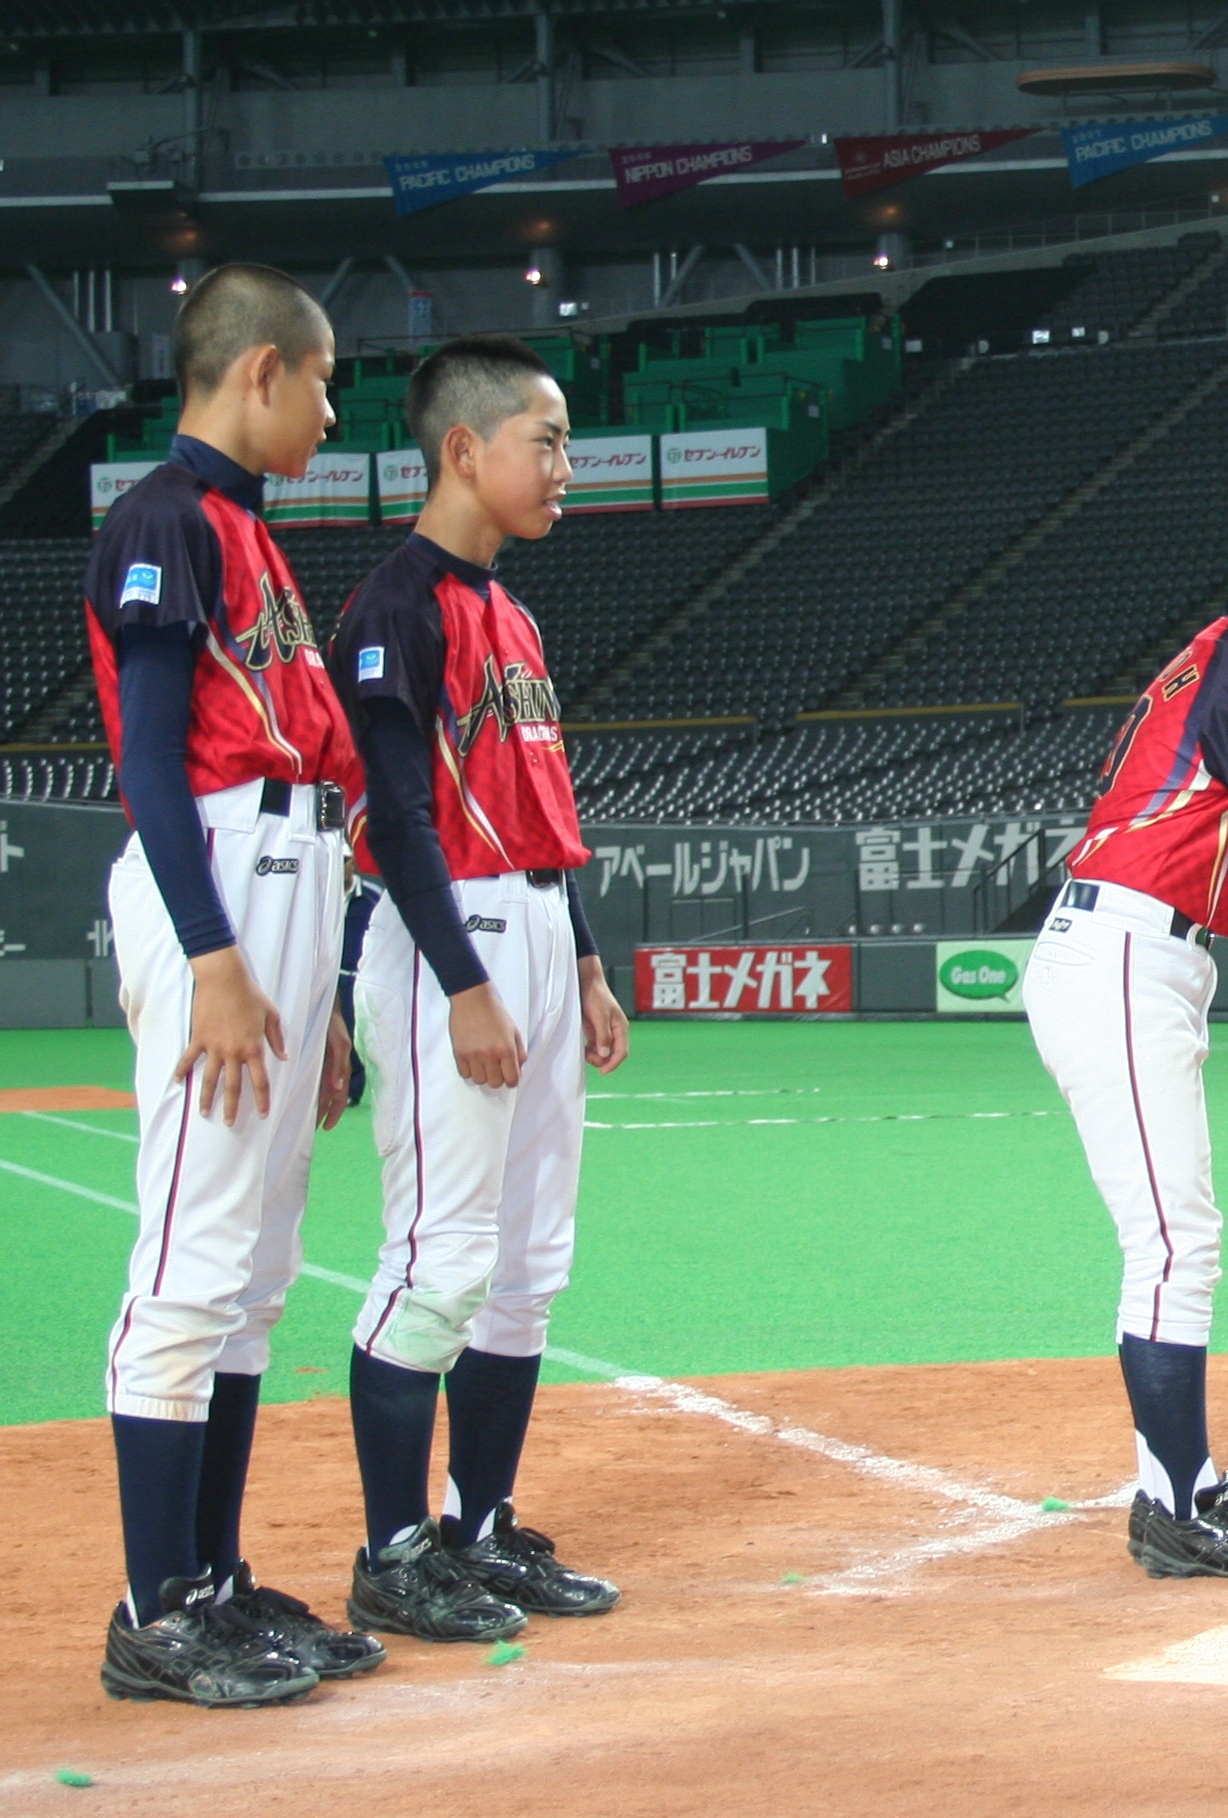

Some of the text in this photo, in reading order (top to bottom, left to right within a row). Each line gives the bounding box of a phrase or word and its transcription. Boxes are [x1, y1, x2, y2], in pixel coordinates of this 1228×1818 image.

[883, 134, 981, 168] ASIA CHAMPIONS
[1075, 120, 1213, 162] PACIFIC CHAMPIONS
[399, 154, 535, 191] PACIFIC CHAMPIONS
[625, 145, 752, 184] NIPPON CHAMPIONS
[595, 836, 811, 898] アベールジャパン
[650, 951, 832, 1010] 富士メガネ
[951, 966, 1007, 985] Gas One
